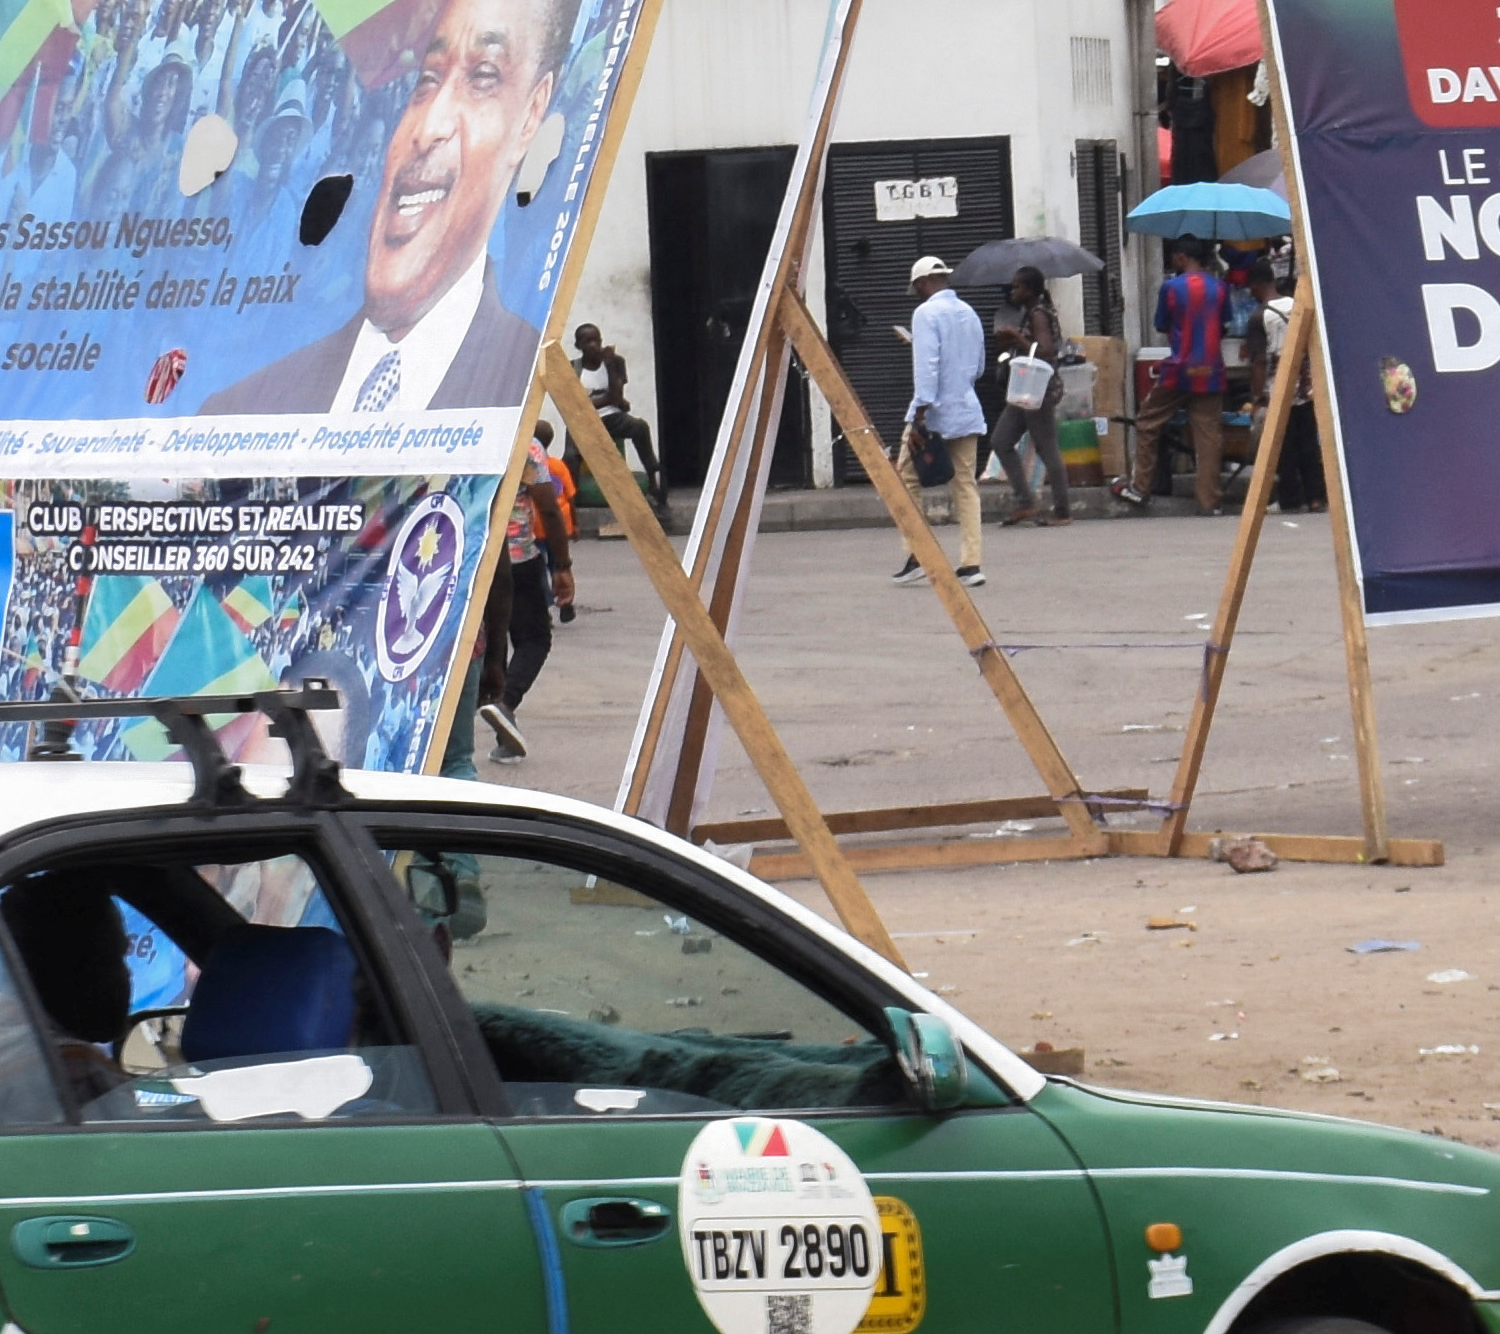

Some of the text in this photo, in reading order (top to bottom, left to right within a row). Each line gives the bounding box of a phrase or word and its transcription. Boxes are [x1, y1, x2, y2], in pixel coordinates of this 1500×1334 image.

[1438, 149, 1491, 185] LE
[12, 213, 109, 251] Sassou
[113, 213, 234, 259] Nguesso,
[537, 210, 571, 291] 2026
[25, 269, 144, 312] stabilité
[145, 269, 210, 310] dans
[210, 267, 239, 307] la
[238, 262, 303, 315] paix
[2, 329, 103, 371] sociale
[160, 425, 300, 459] Développement
[310, 423, 400, 455] Prospérité
[400, 422, 483, 455] partagée
[29, 505, 82, 532] CLUB
[237, 507, 263, 533] ET
[264, 505, 364, 531] REALITES
[191, 545, 229, 572] 360
[232, 545, 275, 571] SUR
[278, 544, 317, 571] 242
[693, 1229, 768, 1280] TBZV
[780, 1224, 869, 1278] 2890
